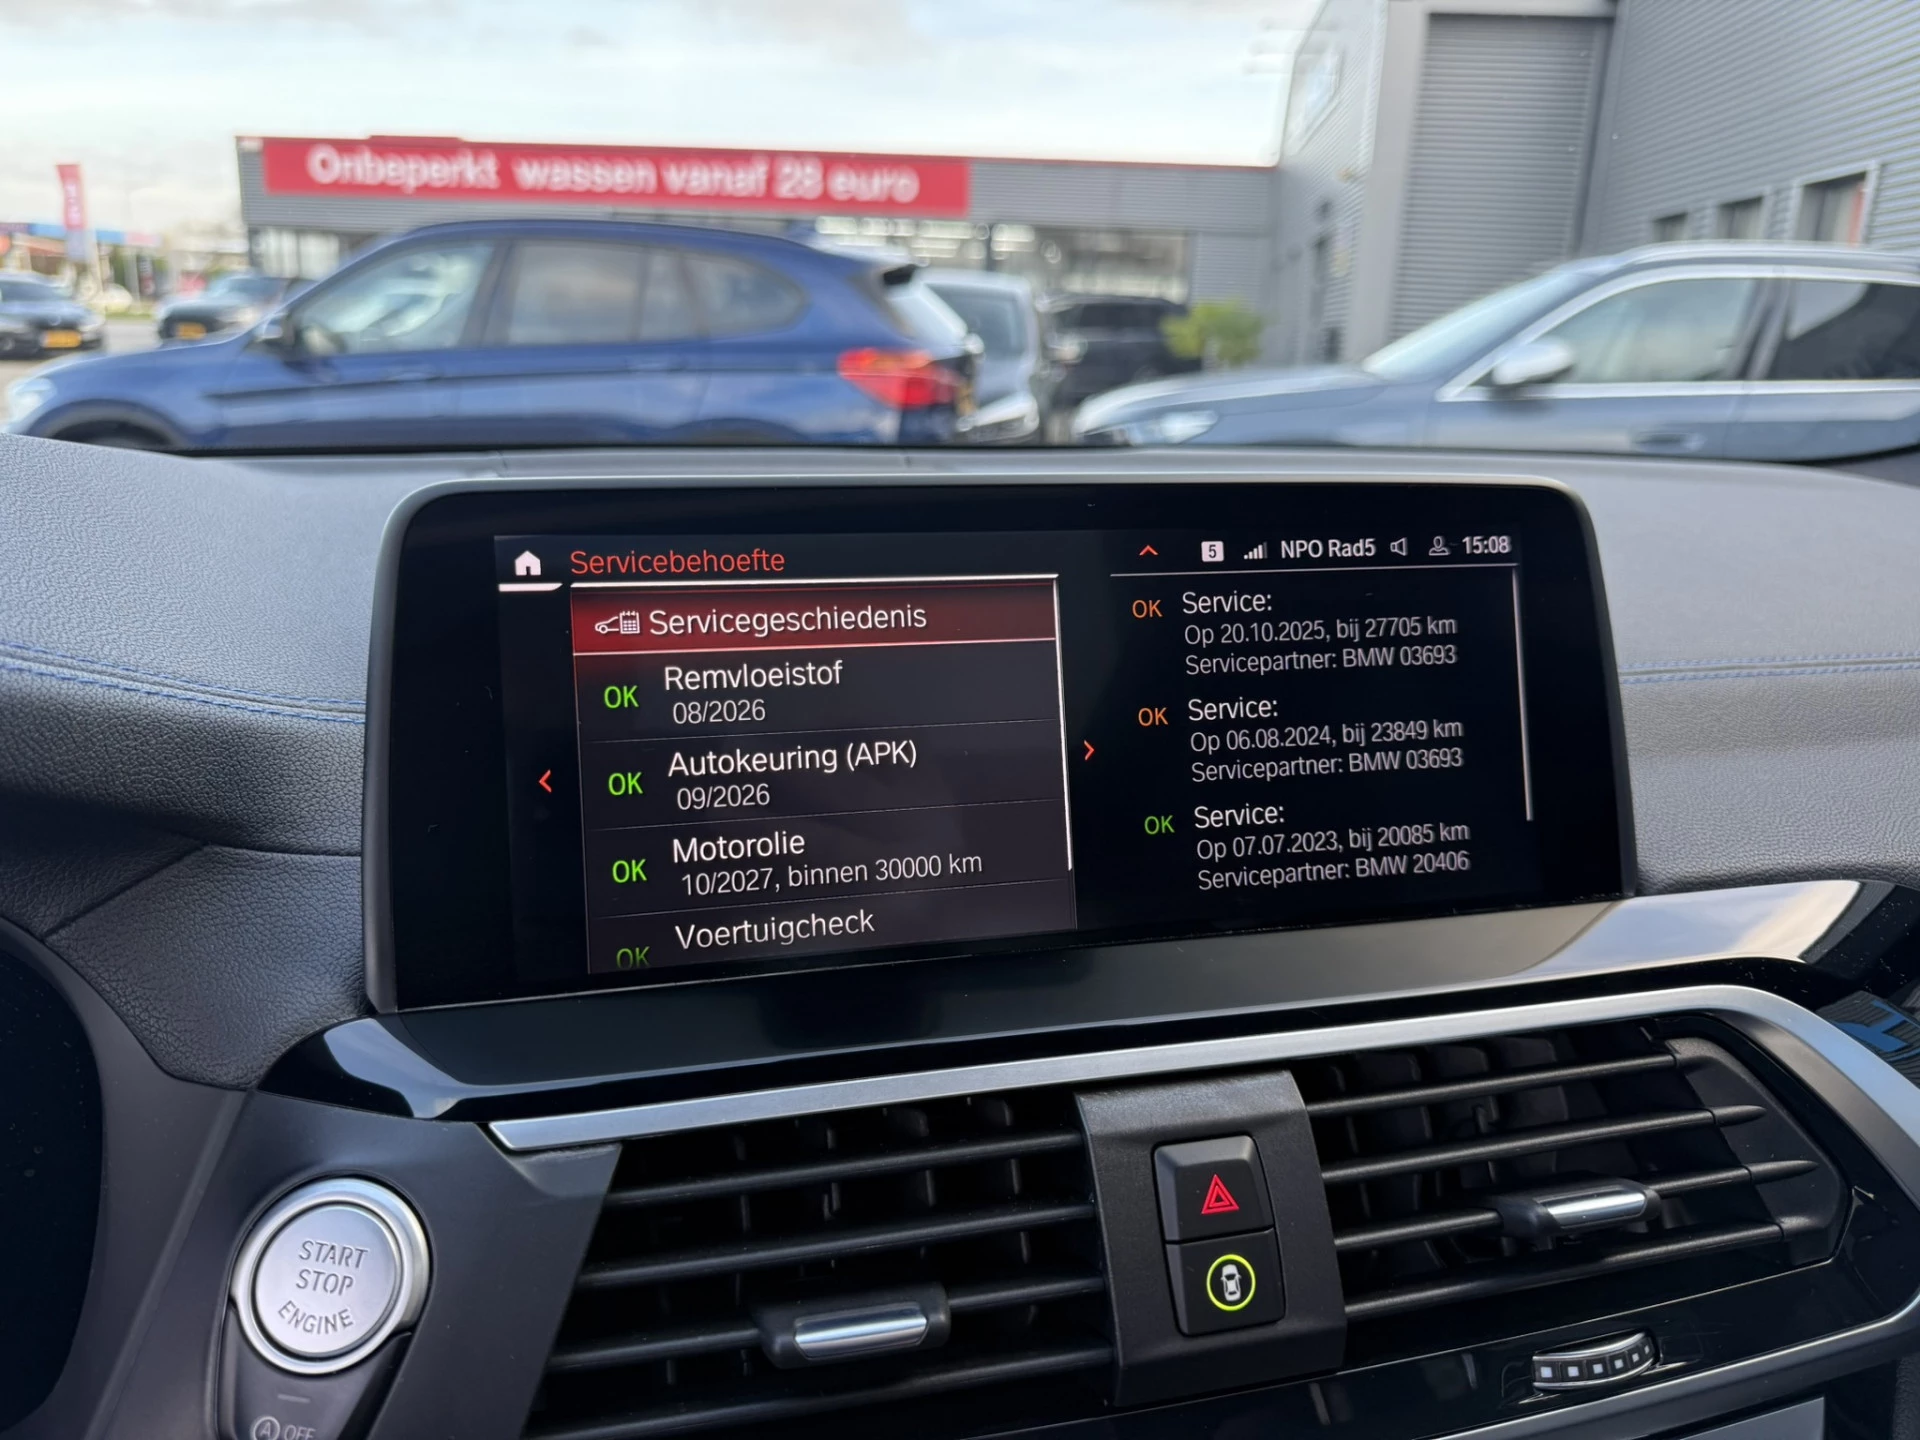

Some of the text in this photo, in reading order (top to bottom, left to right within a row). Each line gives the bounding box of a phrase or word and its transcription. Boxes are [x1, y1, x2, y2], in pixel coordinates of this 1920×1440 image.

[306, 144, 499, 193] Onbeperkt
[512, 156, 656, 194] wassen
[661, 158, 768, 198] vanaf
[826, 164, 919, 203] euro
[1207, 545, 1217, 559] 5
[1280, 538, 1376, 559] NPO Rad5
[1462, 536, 1511, 554] 15:08
[570, 550, 785, 574] Servicebehoefte
[1132, 600, 1162, 618] OK
[1182, 591, 1273, 615] Service:
[649, 604, 927, 636] Servicegeschiedenis
[1184, 616, 1456, 647] Op 20.10.2025, bij 27705 km
[1186, 645, 1457, 675] Servicepartner: BMW 03693
[664, 660, 843, 691] Remvloeistof
[604, 685, 638, 709] OK
[1188, 698, 1279, 722] Service:
[673, 699, 766, 724] 08/2026
[1138, 707, 1168, 726] OK
[1190, 719, 1463, 754] Op 06.08.2024, bij 23849 km
[668, 740, 917, 777] Autokeuring (APK)
[1192, 748, 1463, 783] Servicepartner: BMW 03693
[608, 773, 643, 796] OK
[677, 784, 770, 810] 09/2026
[1145, 815, 1174, 835] OK
[1194, 804, 1285, 829] Service:
[673, 832, 806, 864] Motorolie
[1197, 822, 1470, 863] Op 07.07.2023, bij 20085 km
[612, 859, 647, 884] OK
[682, 852, 983, 897] 10/2027, binnen 30000 km
[1198, 851, 1470, 891] Servicepartner: BMW 20406
[676, 909, 875, 950] Voertuigcheck
[616, 947, 650, 970] OK
[298, 1240, 368, 1269] START
[296, 1269, 354, 1296] STOP
[278, 1300, 354, 1334] ENGINE
[284, 1424, 316, 1440] OFF
